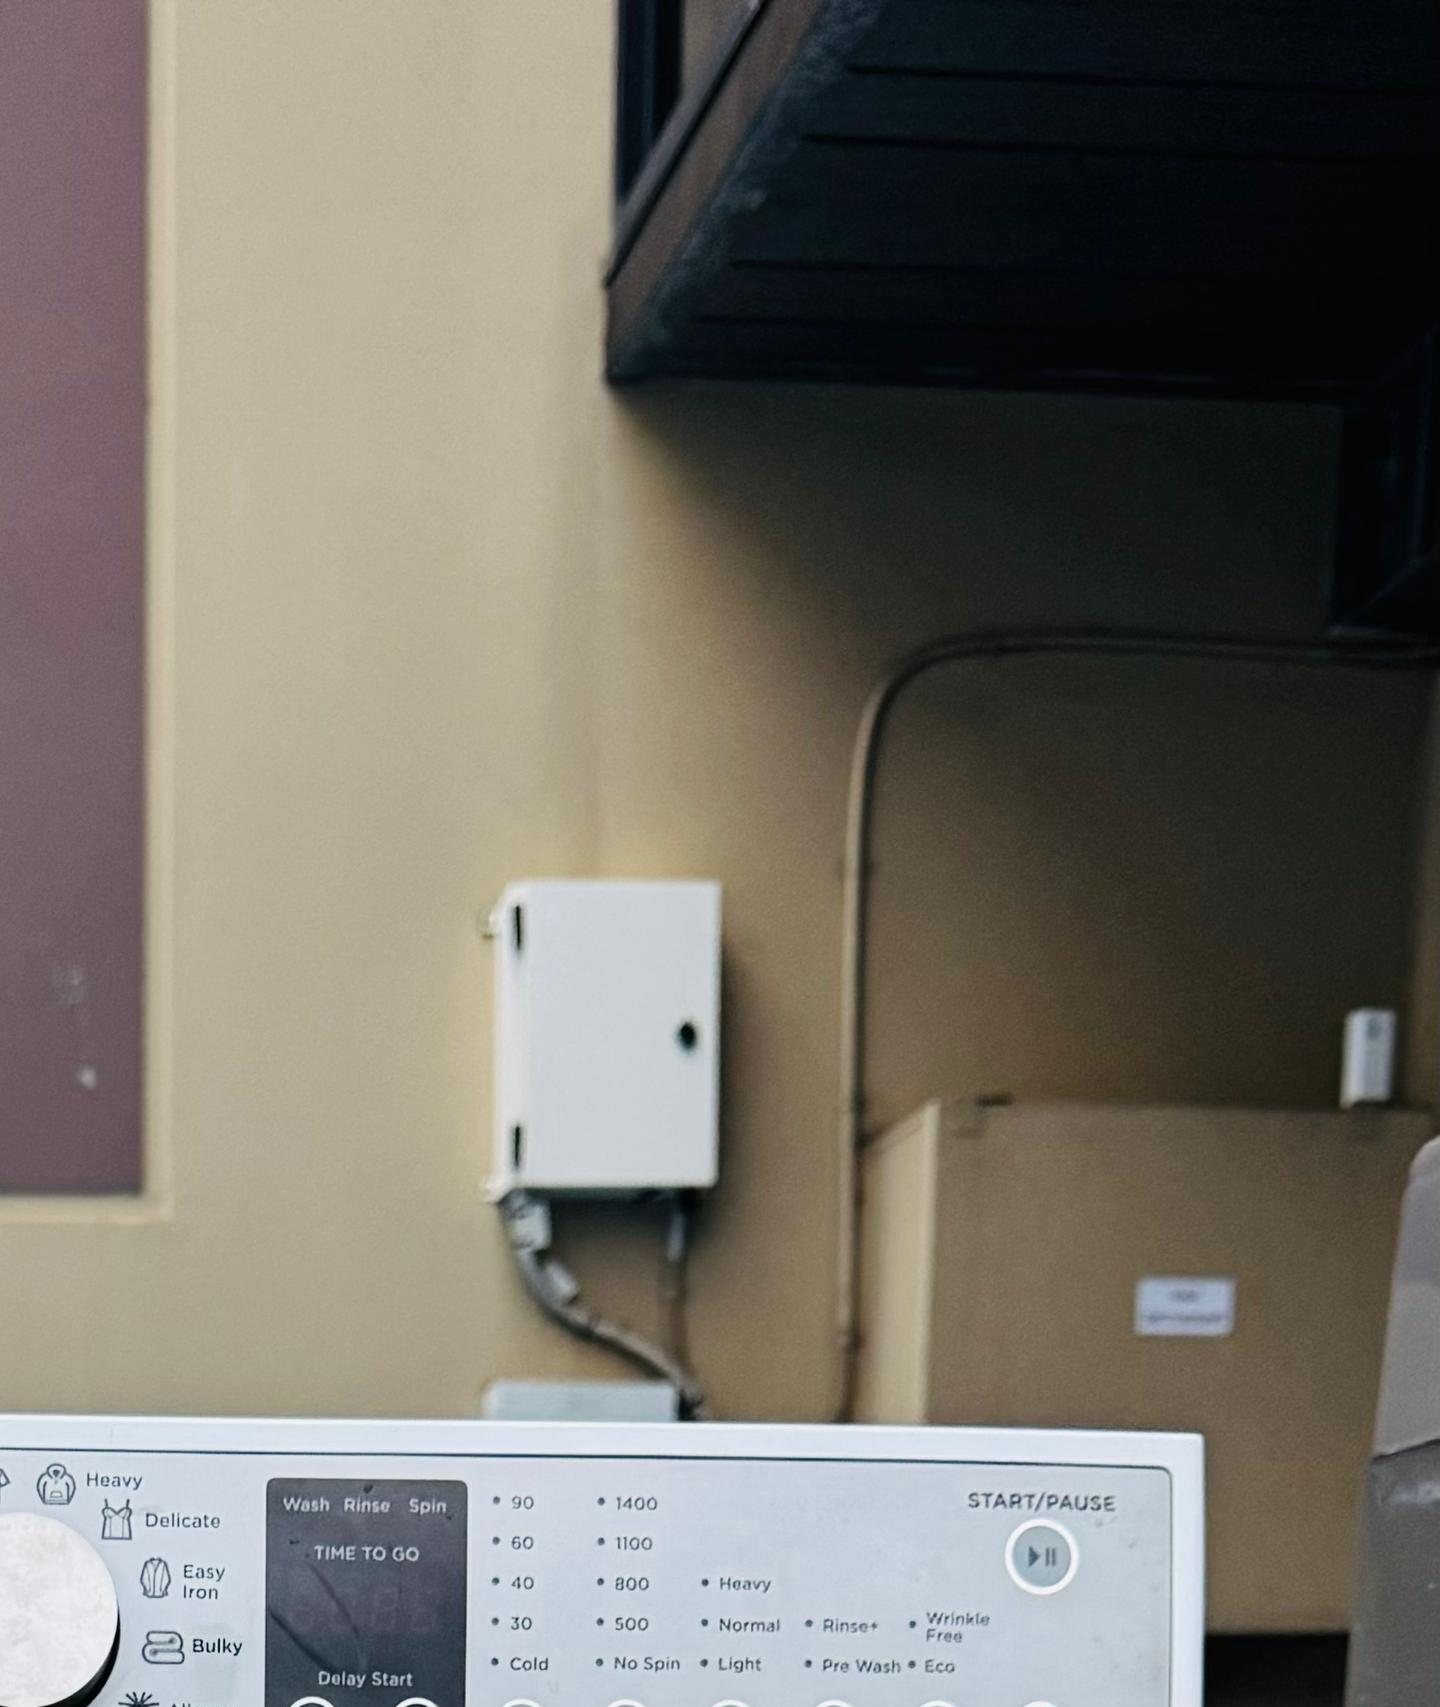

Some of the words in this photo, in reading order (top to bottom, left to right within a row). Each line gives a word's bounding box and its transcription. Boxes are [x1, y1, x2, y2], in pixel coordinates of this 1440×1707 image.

[86, 1472, 143, 1491] Heavy
[282, 1497, 331, 1512] Wash
[343, 1498, 391, 1513] Rinse
[408, 1499, 447, 1516] Spin
[511, 1496, 535, 1510] 90
[615, 1496, 658, 1511] 1400
[967, 1492, 1117, 1513] START/PAUSE
[145, 1512, 221, 1529] Delicate
[511, 1536, 535, 1550] 60
[615, 1537, 653, 1551] 1100
[314, 1546, 356, 1561] TIME
[361, 1547, 387, 1561] TO
[392, 1547, 420, 1562] GO
[183, 1564, 226, 1582] Easy
[511, 1576, 535, 1590] 40
[614, 1577, 650, 1592] 800
[719, 1576, 771, 1594] Heavy
[182, 1583, 219, 1600] Iron
[510, 1617, 533, 1631] 30
[614, 1617, 649, 1631] 500
[719, 1617, 781, 1633] Normal
[822, 1618, 879, 1634] Rinse+
[925, 1612, 990, 1627] Wrinkle
[925, 1629, 963, 1644] Free
[192, 1637, 243, 1657] Bulky
[509, 1657, 549, 1672] Cold
[613, 1657, 638, 1671] No
[643, 1657, 681, 1674] Spin
[718, 1657, 762, 1674] Light
[822, 1658, 852, 1674] Pre
[856, 1658, 901, 1674] Wash
[924, 1659, 955, 1674] Eco
[317, 1671, 366, 1688] Delay
[371, 1672, 413, 1687] Start
